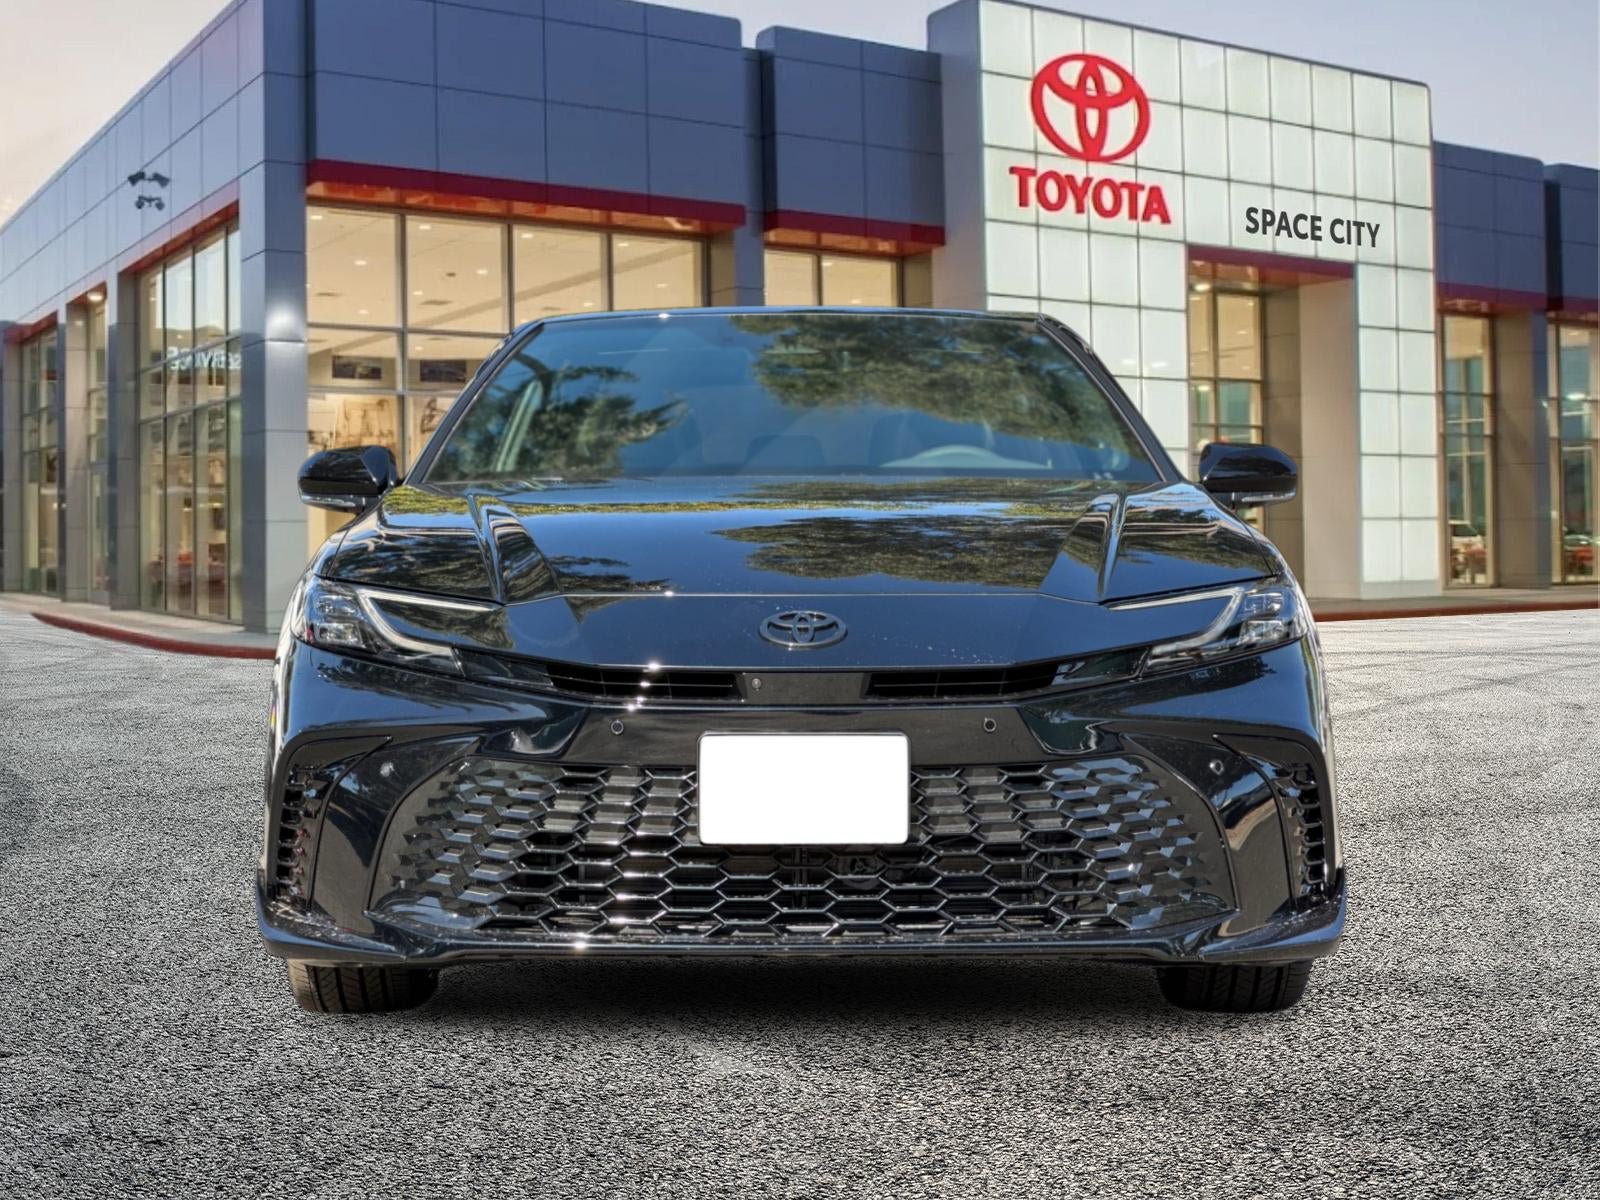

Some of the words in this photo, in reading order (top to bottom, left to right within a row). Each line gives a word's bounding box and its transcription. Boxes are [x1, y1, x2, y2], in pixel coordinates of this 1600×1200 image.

[1009, 165, 1171, 224] TOYOTA
[1245, 206, 1322, 242] SPACE
[1329, 217, 1380, 248] CITY
